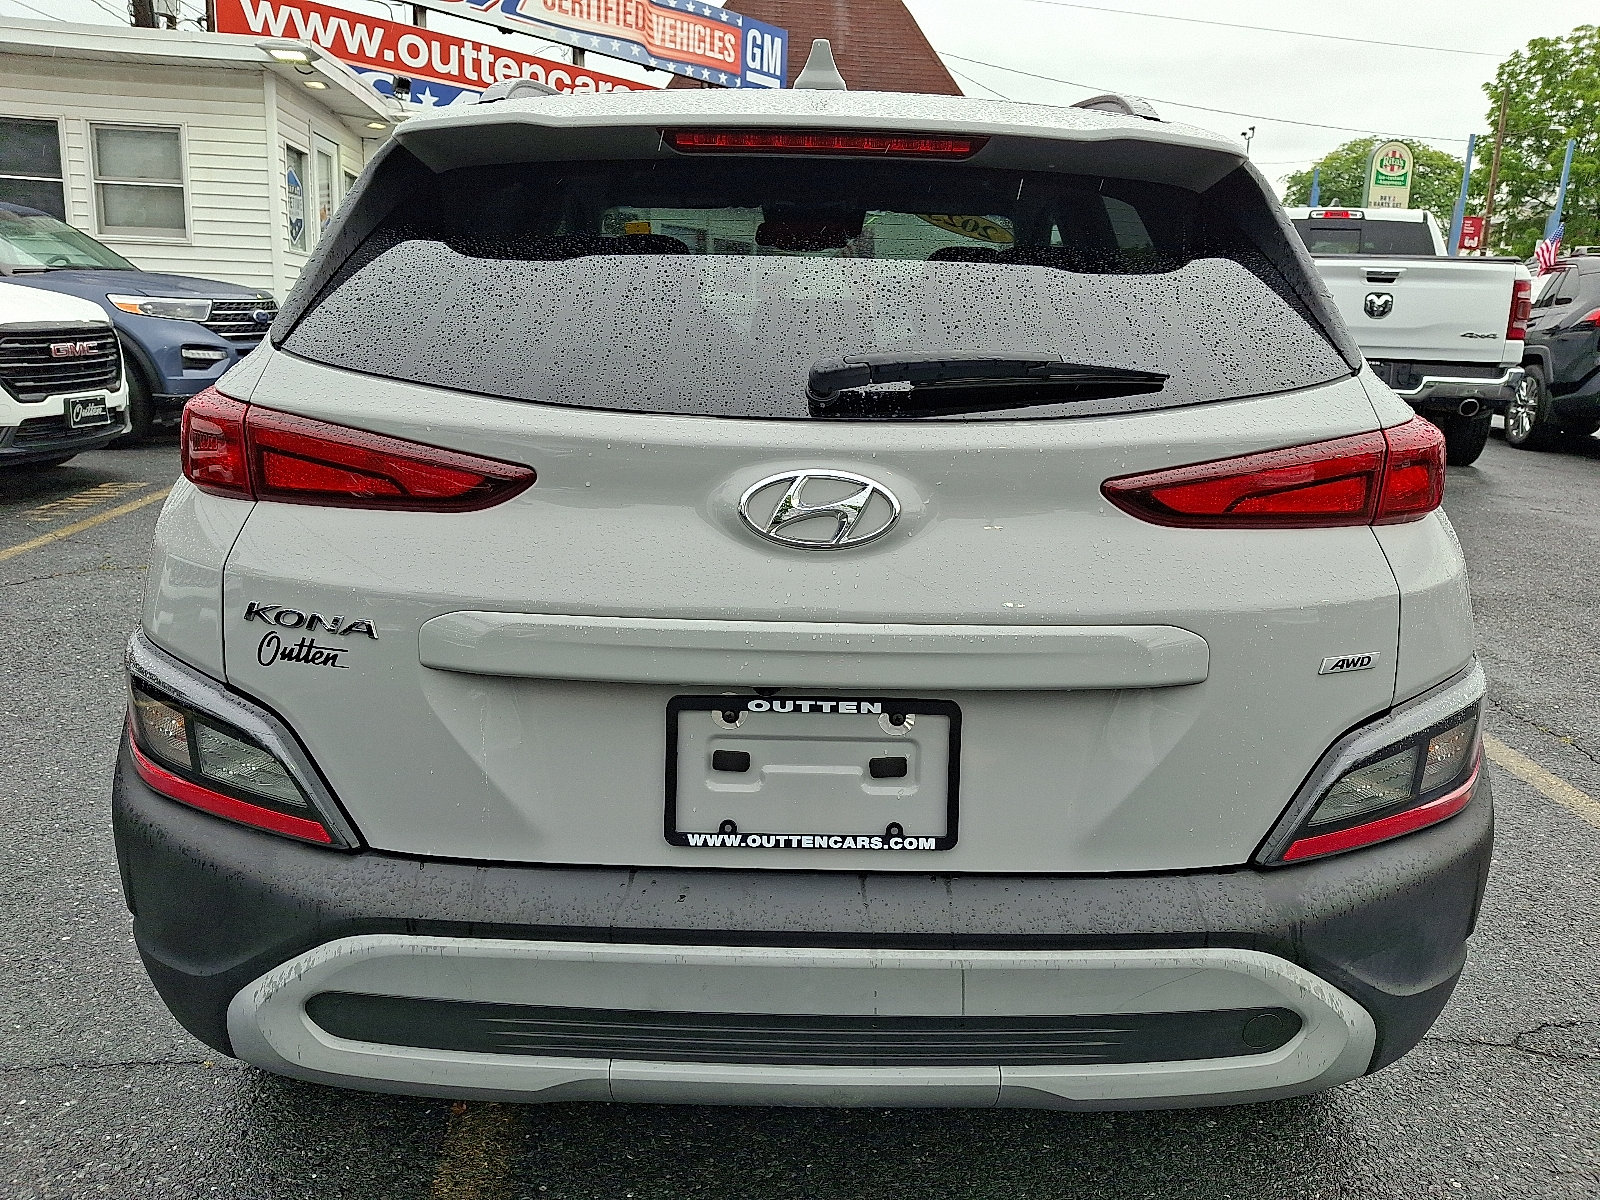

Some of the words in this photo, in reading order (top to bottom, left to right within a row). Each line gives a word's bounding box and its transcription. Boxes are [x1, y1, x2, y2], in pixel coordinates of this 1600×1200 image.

[240, 0, 632, 94] www.outtencar
[651, 13, 736, 63] VEHICLES
[746, 28, 782, 77] GM
[50, 341, 99, 358] GMC
[73, 402, 107, 422] Outten
[244, 600, 379, 640] KONA
[257, 630, 350, 669] Outten
[1329, 655, 1372, 671] AWD
[747, 699, 882, 714] OUTTEN
[687, 833, 936, 850] WWW.OUTTENCARS.COM
